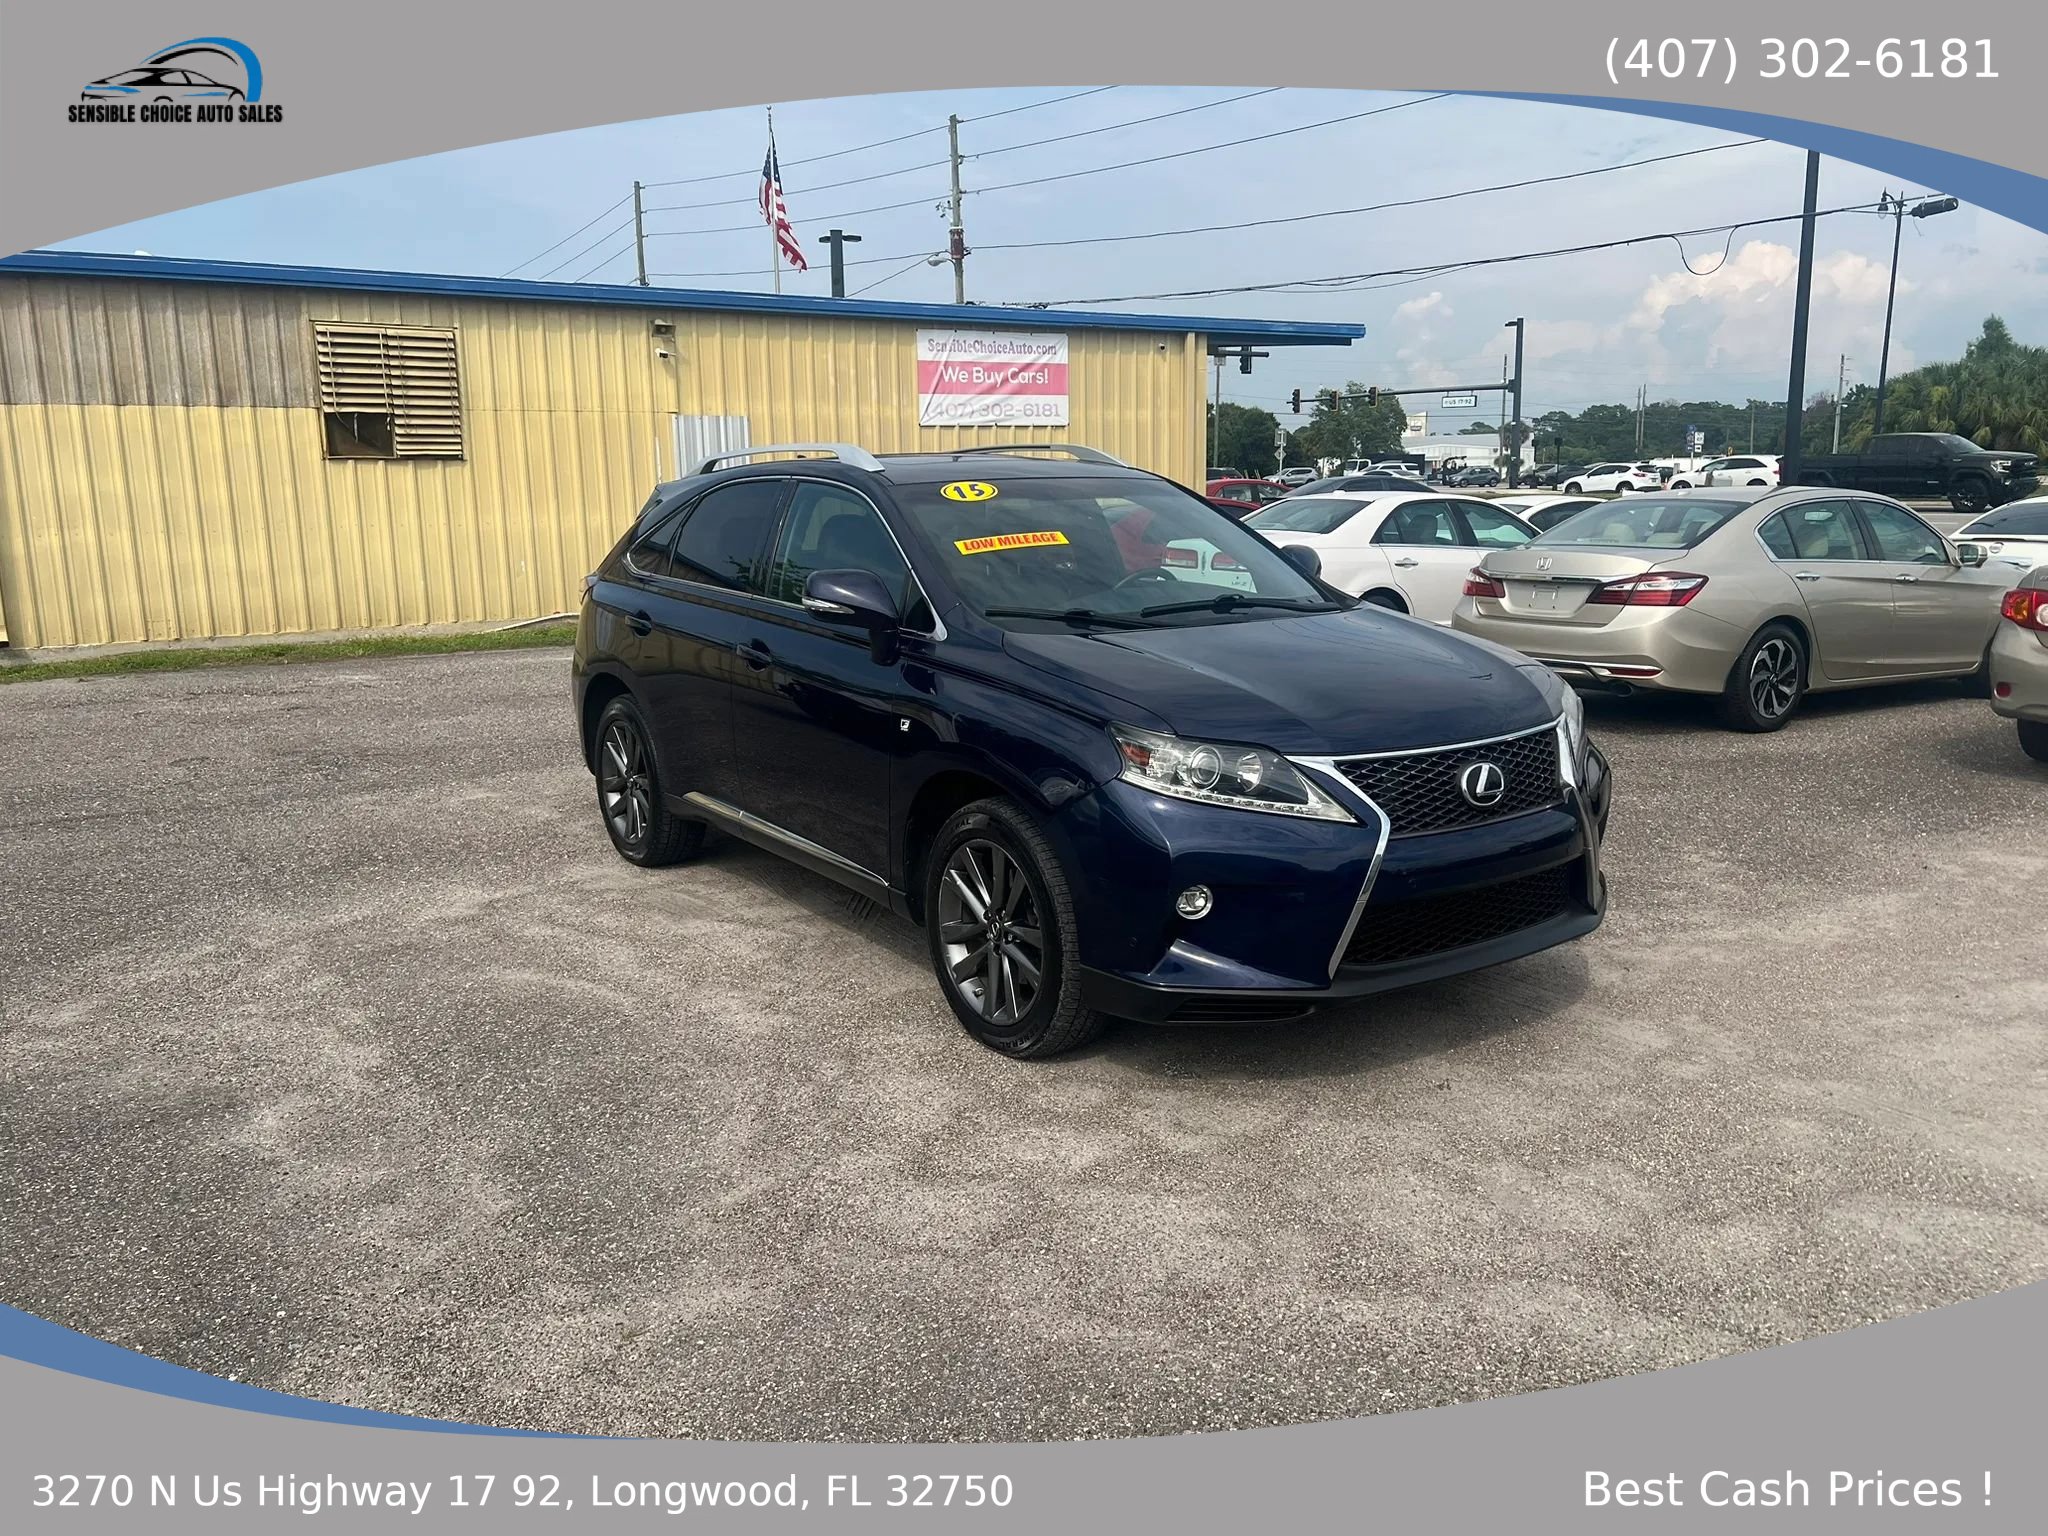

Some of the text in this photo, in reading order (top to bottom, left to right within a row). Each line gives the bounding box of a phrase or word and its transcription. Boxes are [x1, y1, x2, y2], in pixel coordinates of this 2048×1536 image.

[928, 338, 1057, 355] SensibleChoiceAuto.com
[941, 366, 1049, 388] We Buy Cars!
[979, 402, 1060, 418] 302-6181
[953, 483, 985, 499] 15
[963, 532, 1059, 551] LOW MILEAGE
